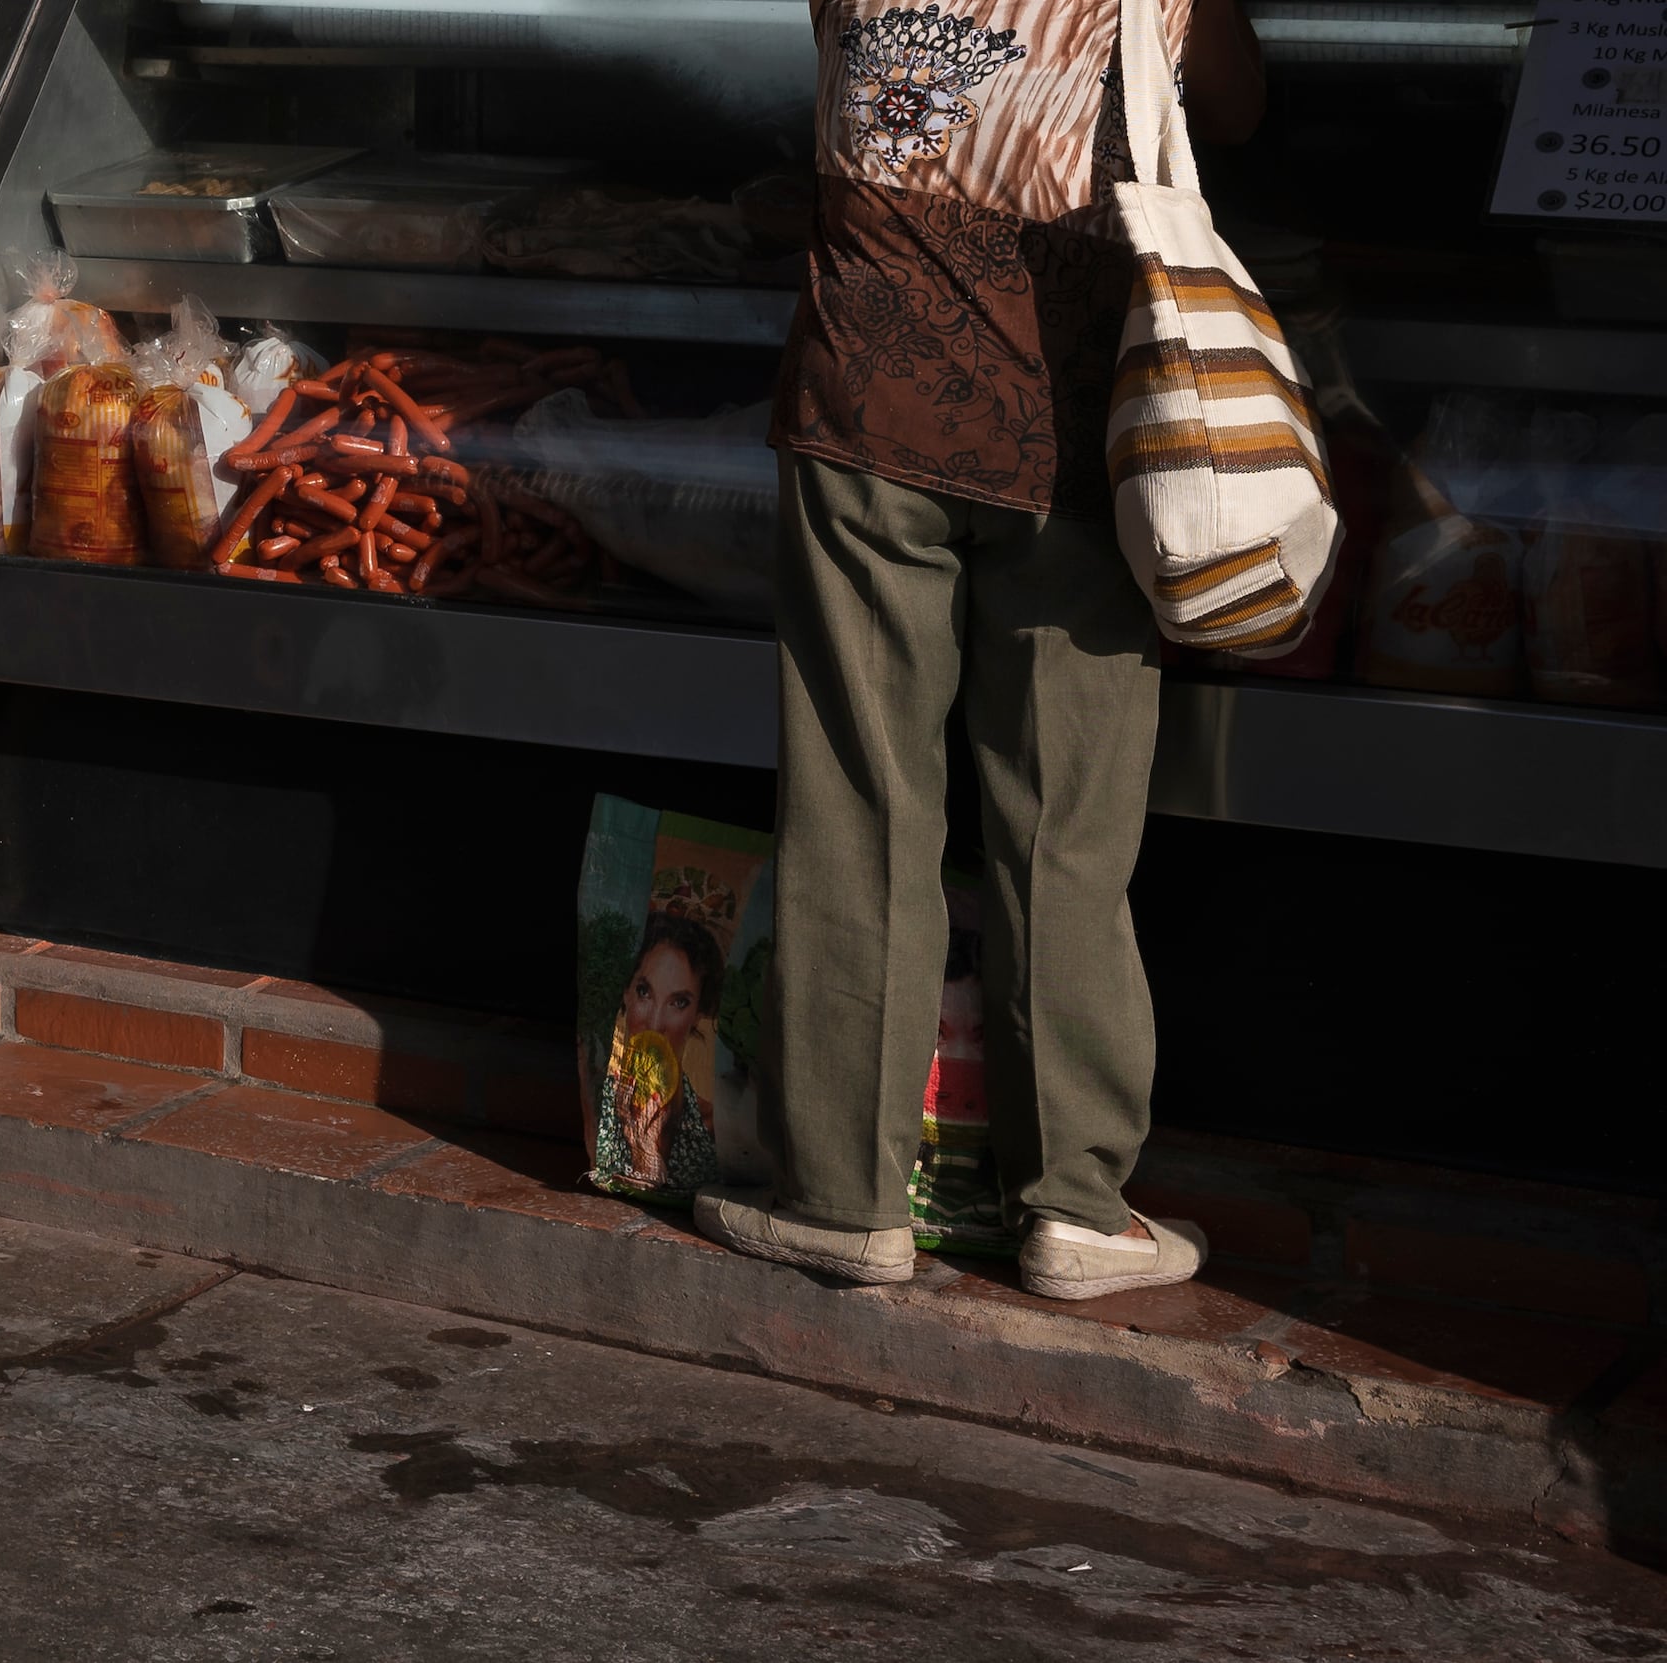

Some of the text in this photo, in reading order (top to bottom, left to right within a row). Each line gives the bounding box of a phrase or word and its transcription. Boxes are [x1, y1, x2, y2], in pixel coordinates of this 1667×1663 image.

[1587, 22, 1609, 38] Kg
[1593, 47, 1646, 64] 10 Kg
[1572, 104, 1660, 119] Milanesa
[1569, 134, 1660, 157] 36.50
[1585, 168, 1609, 184] Kg
[1615, 169, 1639, 183] de
